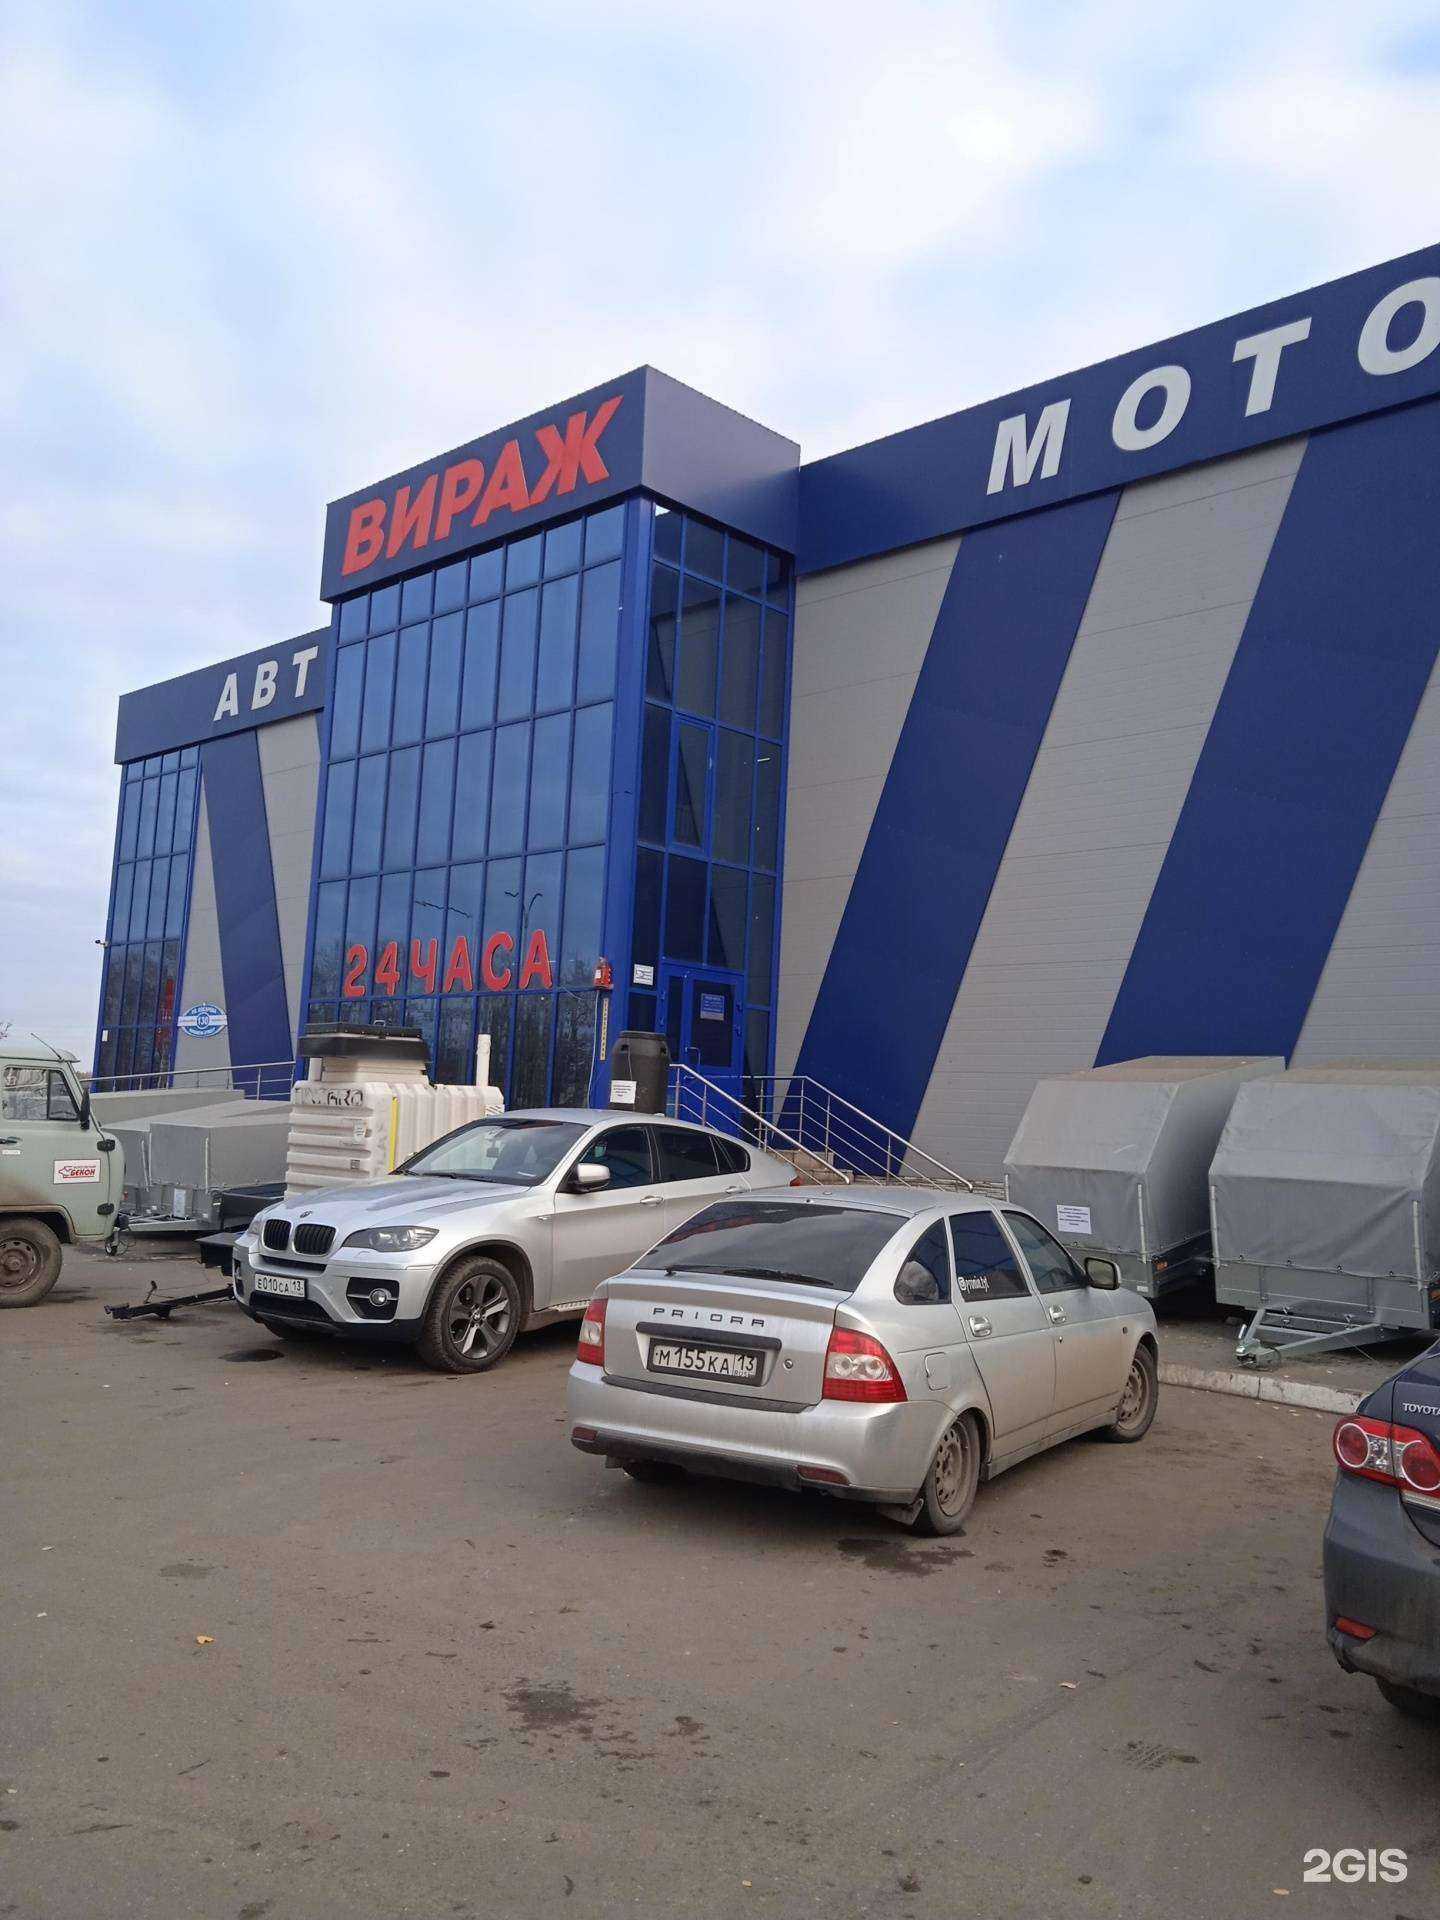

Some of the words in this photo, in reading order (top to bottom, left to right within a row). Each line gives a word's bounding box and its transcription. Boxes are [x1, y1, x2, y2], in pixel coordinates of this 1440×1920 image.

[341, 395, 624, 576] ВИРАЖ
[292, 1280, 301, 1291] 13
[652, 1307, 765, 1328] PRIORA
[737, 1354, 754, 1372] 13
